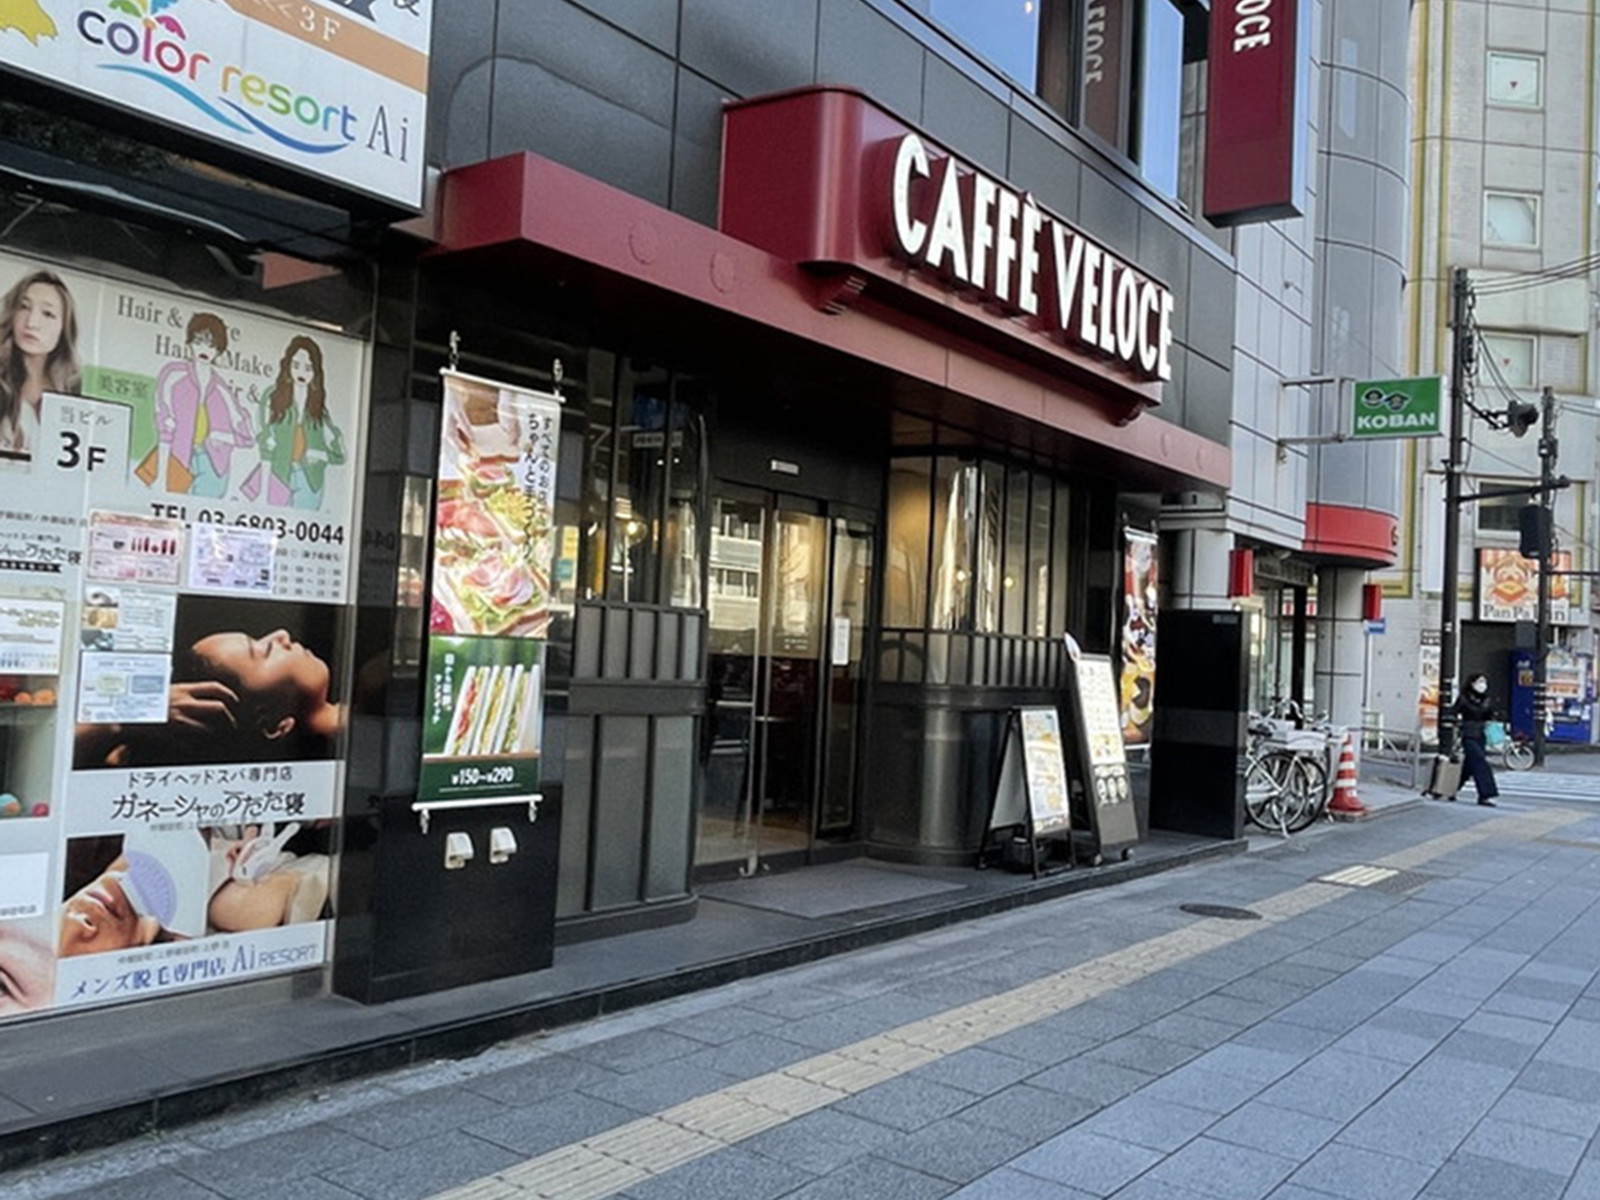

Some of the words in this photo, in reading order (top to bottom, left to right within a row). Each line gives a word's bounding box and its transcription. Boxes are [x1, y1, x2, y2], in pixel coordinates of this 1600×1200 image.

[77, 9, 210, 80] color
[220, 65, 358, 142] resort
[366, 105, 409, 163] Ai
[893, 132, 1042, 315] CAFFÈ
[1052, 219, 1174, 381] VELOCE
[118, 295, 162, 323] Hair
[167, 307, 184, 329] &
[223, 350, 273, 378] Make
[60, 404, 114, 426] 当ビル
[1357, 412, 1435, 429] KOBAN
[57, 430, 107, 472] 3F
[128, 766, 293, 789] ドライヘッドスパ専門店
[111, 789, 306, 823] ガネーシャのうたた寝
[257, 943, 320, 968] RESORT
